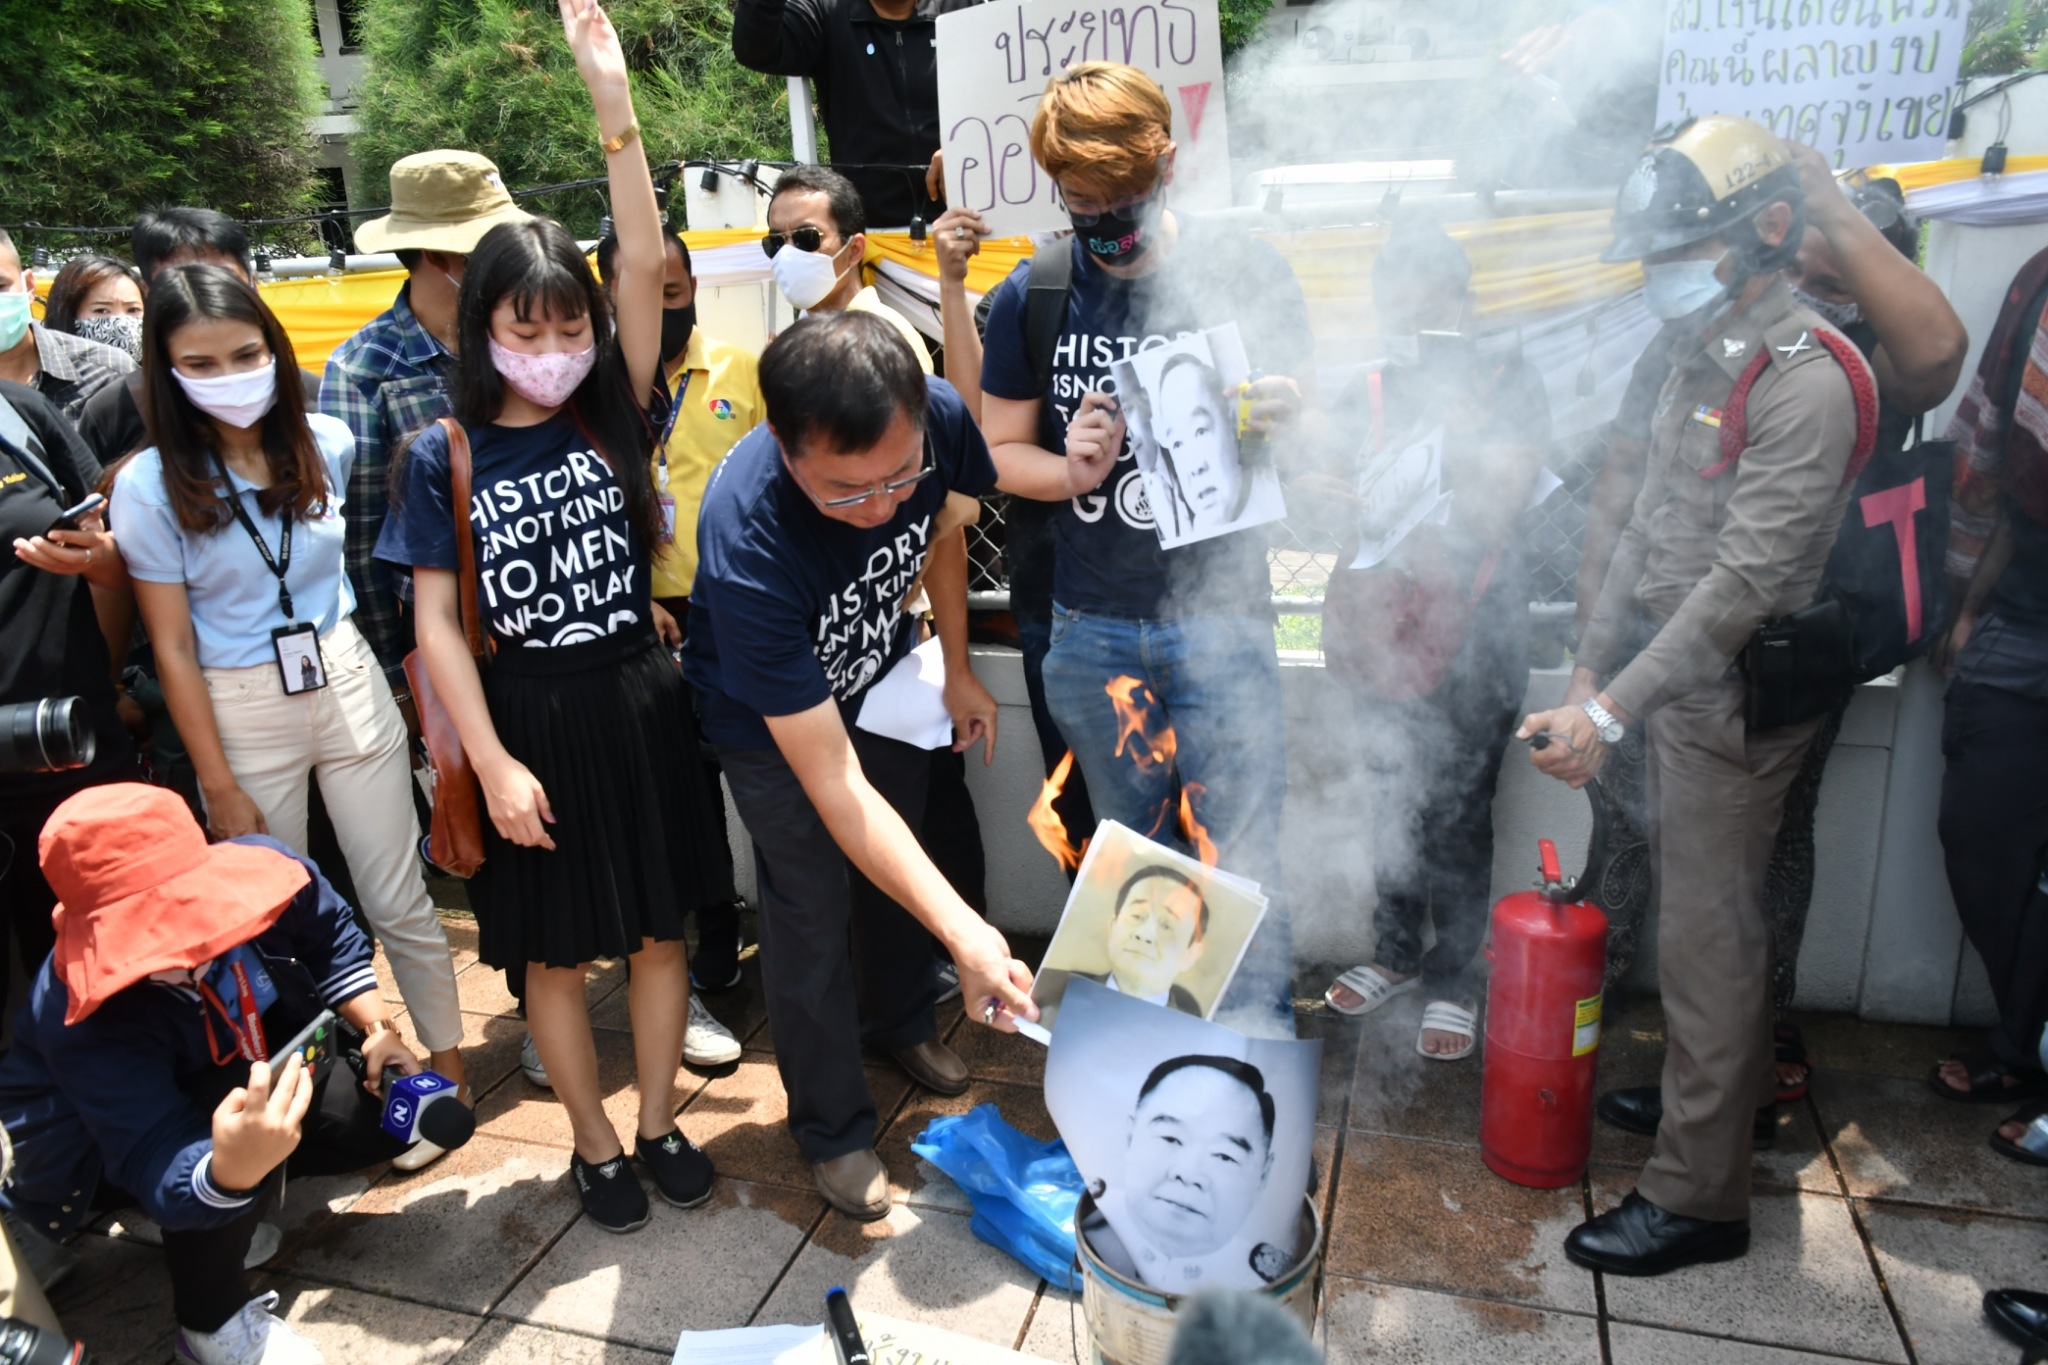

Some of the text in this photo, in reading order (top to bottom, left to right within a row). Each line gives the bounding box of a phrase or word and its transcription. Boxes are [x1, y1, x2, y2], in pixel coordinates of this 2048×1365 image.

[1052, 331, 1195, 368] HIST
[1073, 373, 1119, 399] NO
[469, 449, 614, 528] HISTORY
[489, 510, 555, 555] NOT
[560, 486, 625, 530] KIND
[481, 559, 538, 608] TO
[550, 520, 630, 583] MEN
[493, 592, 565, 637] WHO
[572, 565, 636, 613] PLAY
